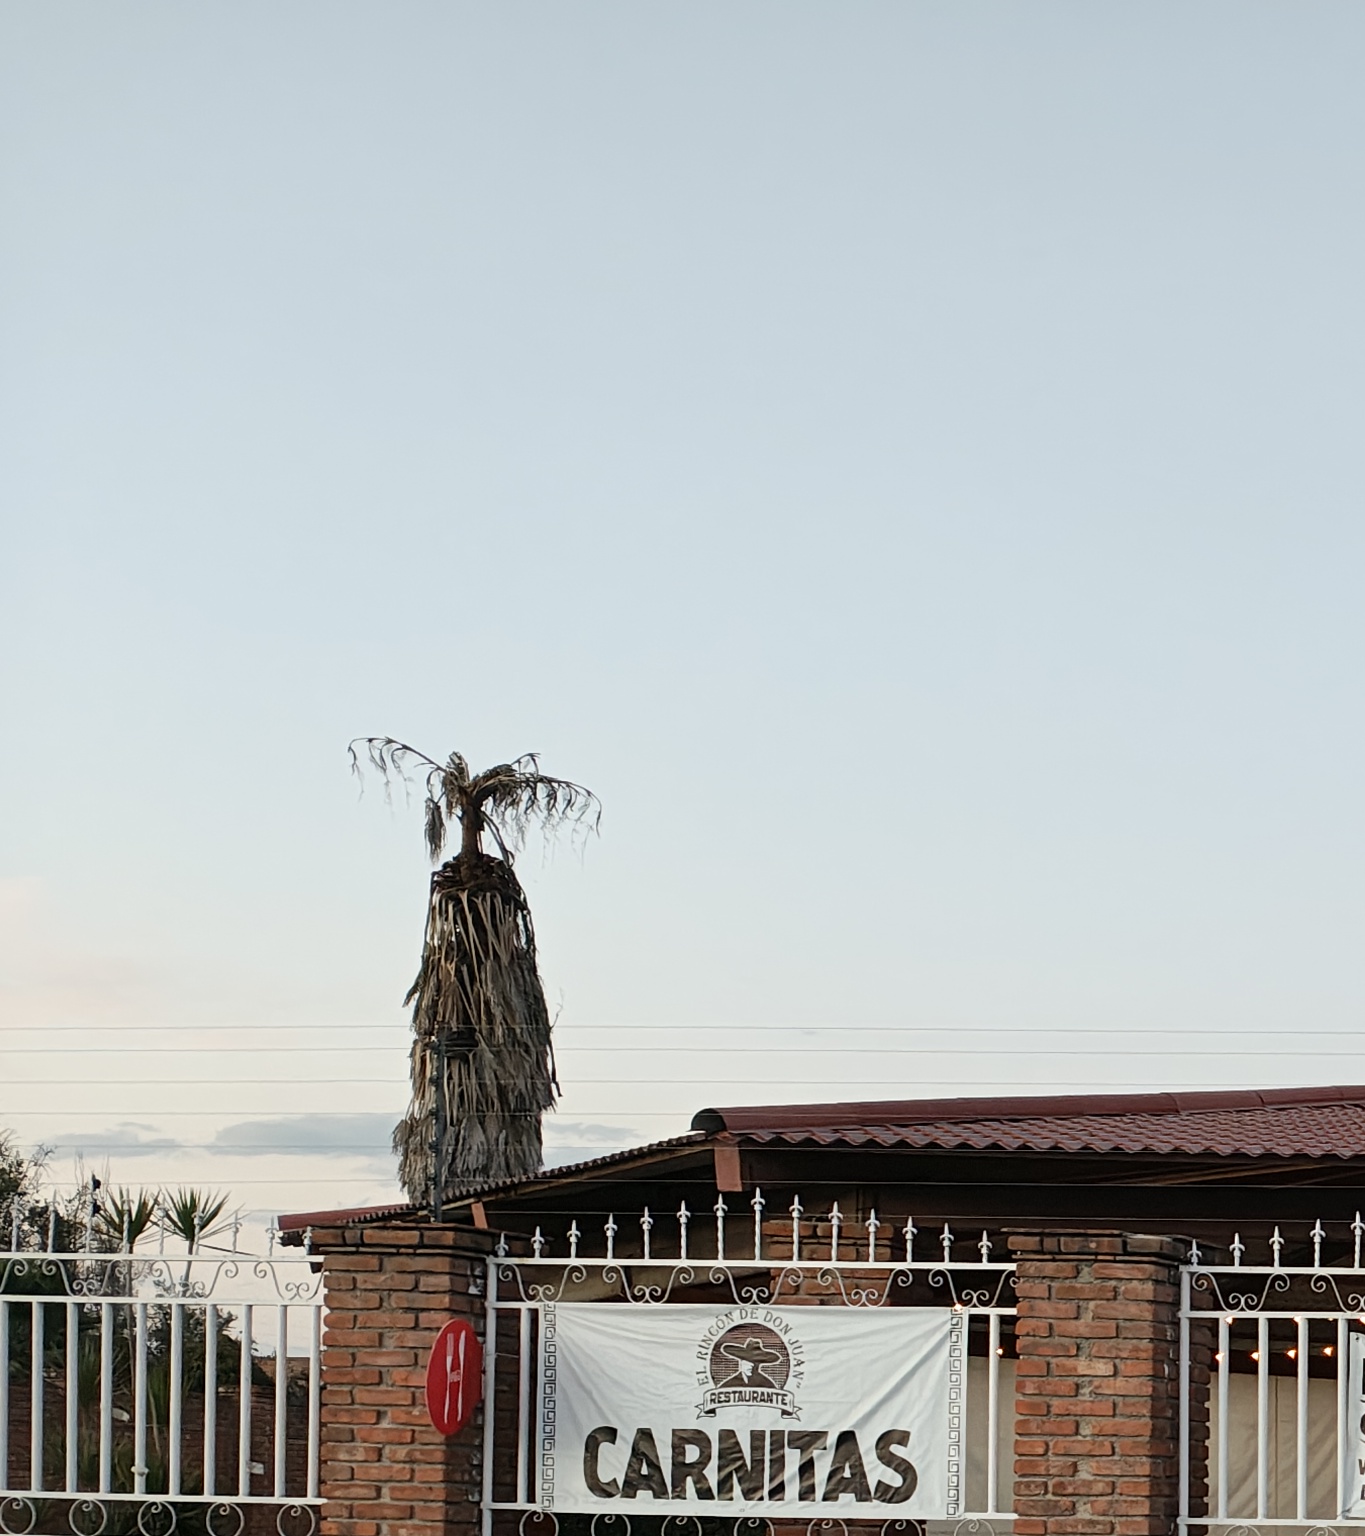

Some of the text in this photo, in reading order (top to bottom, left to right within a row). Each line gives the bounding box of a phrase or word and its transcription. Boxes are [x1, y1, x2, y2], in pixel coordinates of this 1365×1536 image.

[739, 1308, 759, 1320] DE
[763, 1310, 794, 1336] DON
[696, 1310, 734, 1361] RINCÓN
[695, 1365, 710, 1387] EL
[709, 1390, 788, 1406] RESTAURANTE
[583, 1425, 919, 1505] CARNITAS
